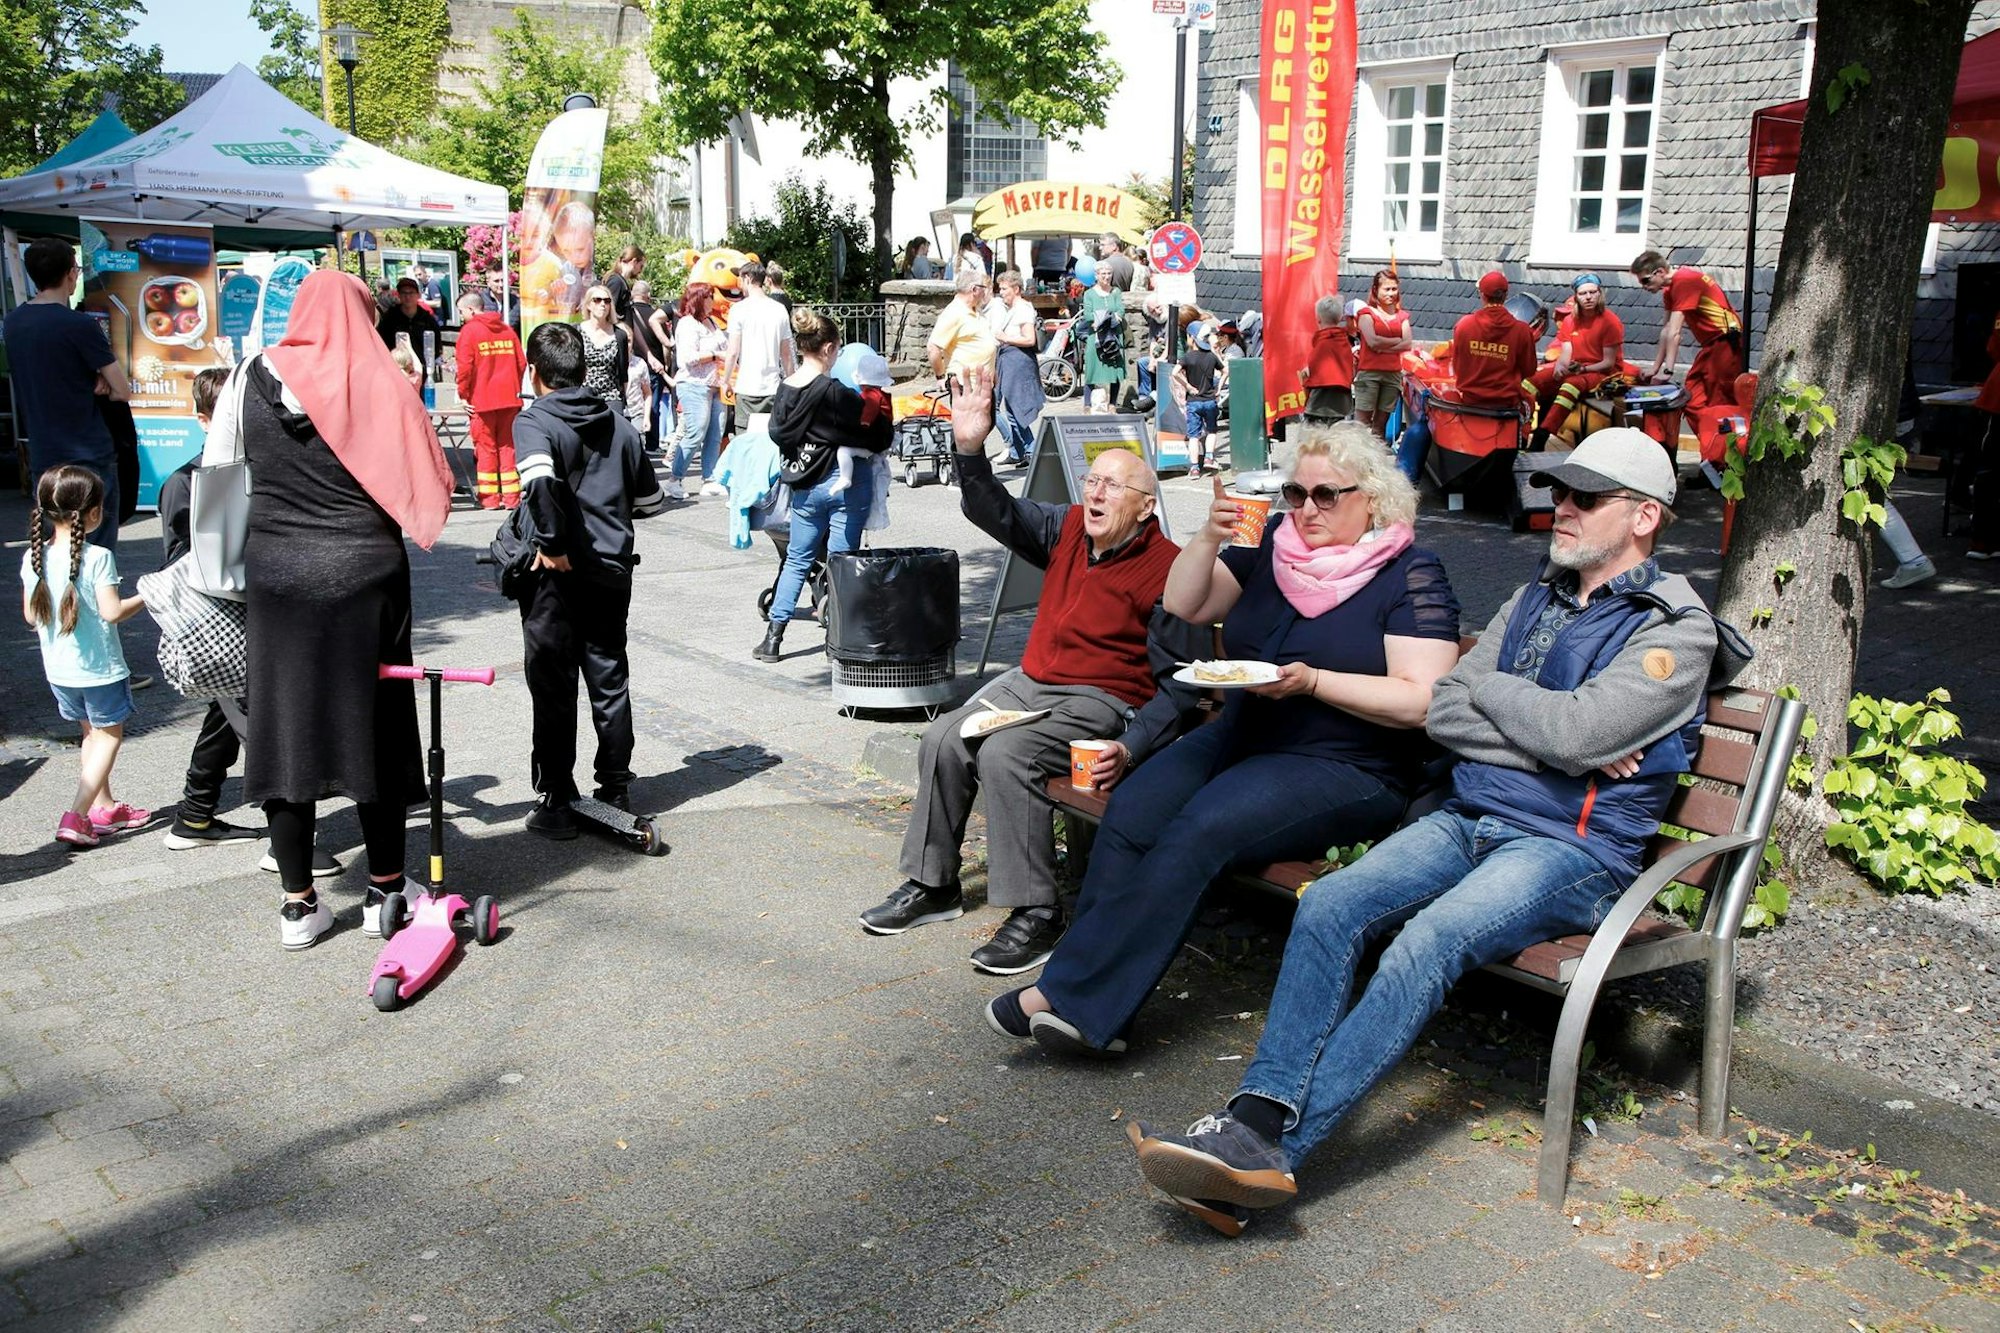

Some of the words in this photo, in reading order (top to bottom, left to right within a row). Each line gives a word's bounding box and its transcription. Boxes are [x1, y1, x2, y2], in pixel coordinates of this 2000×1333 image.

[1195, 3, 1211, 13] AfD
[1265, 8, 1297, 190] DLRG
[221, 143, 291, 156] KLEINE
[1469, 340, 1509, 354] DLRG
